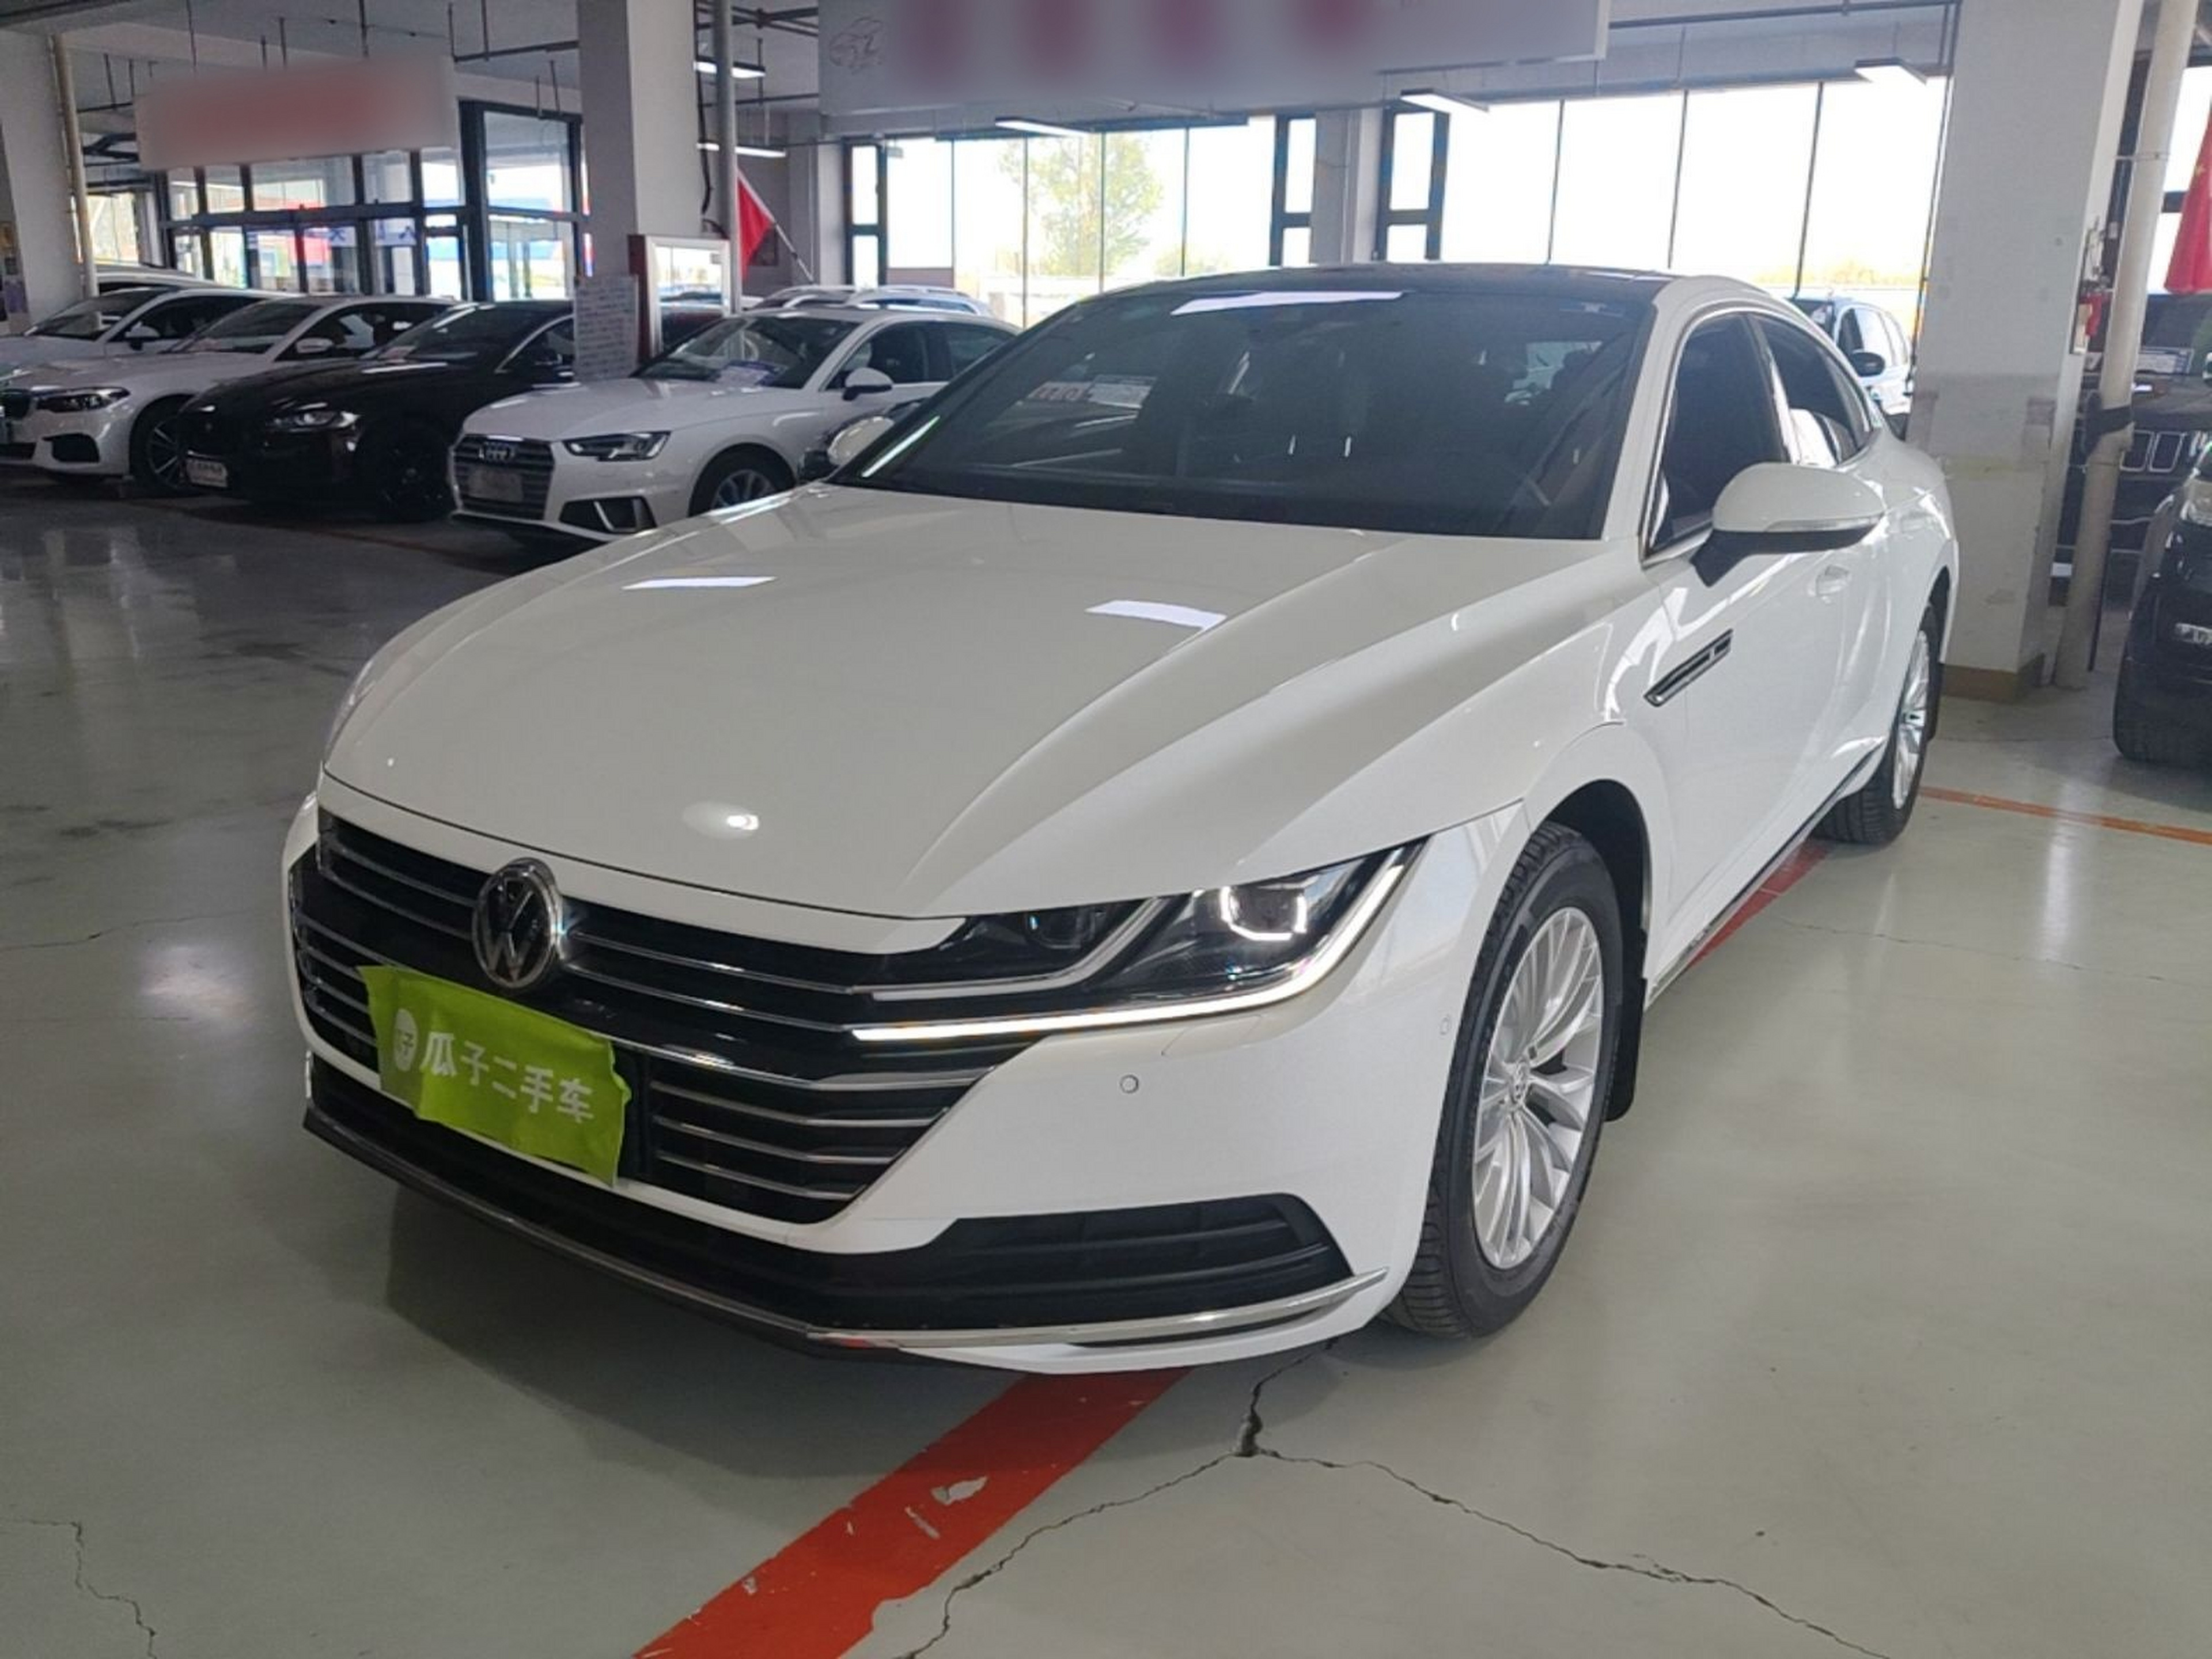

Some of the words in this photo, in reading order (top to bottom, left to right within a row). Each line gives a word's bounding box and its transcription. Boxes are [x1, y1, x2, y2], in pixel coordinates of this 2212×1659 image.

[420, 1032, 594, 1123] 瓜子二手车
